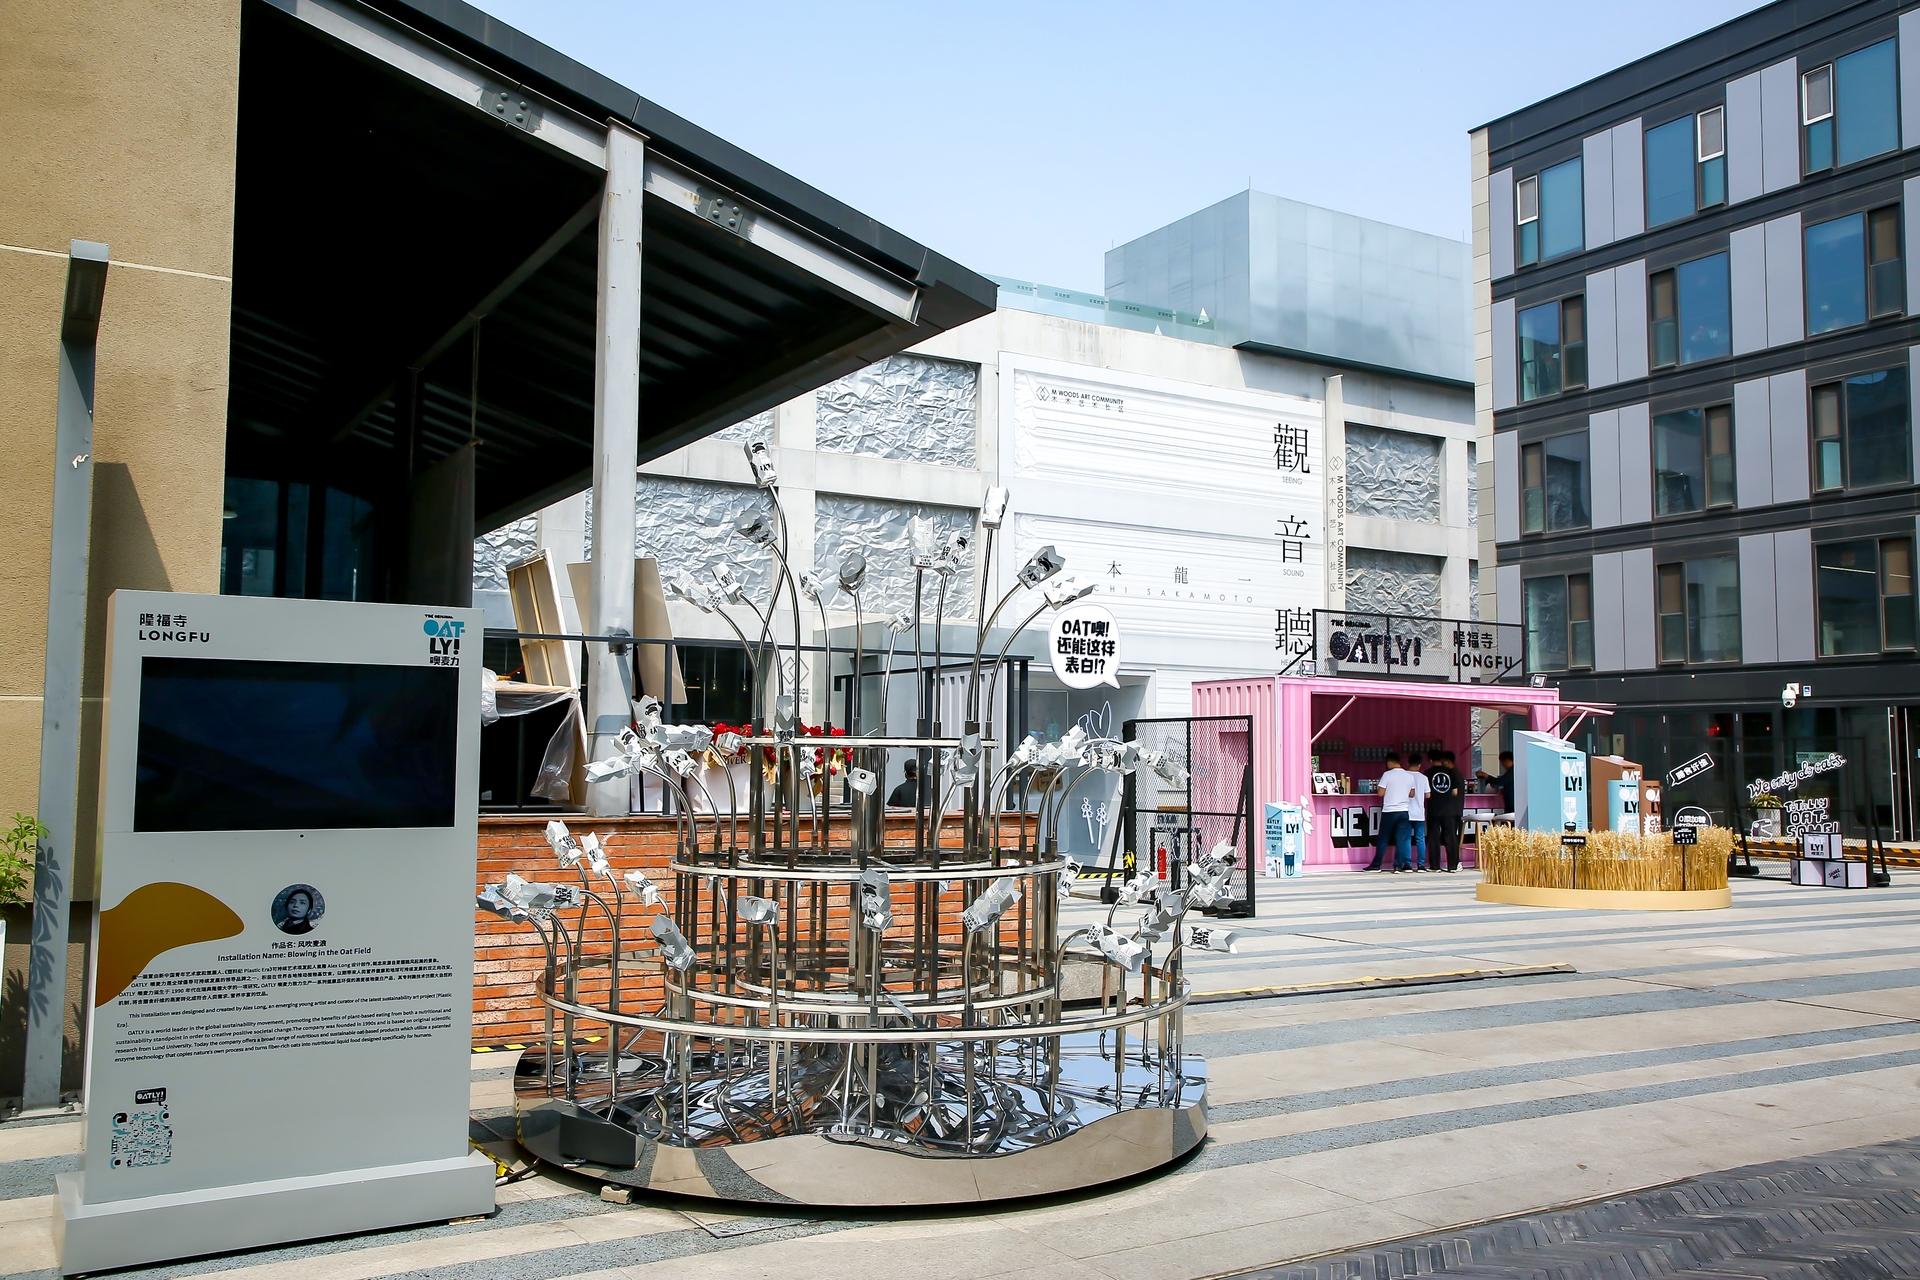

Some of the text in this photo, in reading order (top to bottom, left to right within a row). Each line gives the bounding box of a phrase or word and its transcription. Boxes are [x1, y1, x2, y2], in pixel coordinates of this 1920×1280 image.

[1058, 390, 1080, 399] WOODS
[1091, 395, 1124, 405] COMMUNITY
[1273, 423, 1311, 474] 觀
[1336, 475, 1344, 484] M
[1274, 515, 1311, 564] 音
[1337, 538, 1345, 591] COMMUNITY
[1146, 587, 1254, 604] SAKAMOTO
[139, 613, 188, 628] 隆福寺
[139, 630, 211, 643] LONGFU
[1275, 607, 1313, 656] 聽
[429, 637, 460, 655] LY!
[1057, 637, 1115, 656] 还能这样
[1329, 630, 1422, 668] OATLY!
[1453, 652, 1513, 670] LONGFU
[1565, 776, 1583, 792] LY!
[1285, 823, 1299, 834] LY!
[1810, 843, 1824, 852] LY!
[217, 952, 261, 961] Installation
[262, 951, 286, 959] Name:
[287, 949, 317, 960] Blowing
[326, 948, 339, 956] the
[339, 947, 353, 955] Oat
